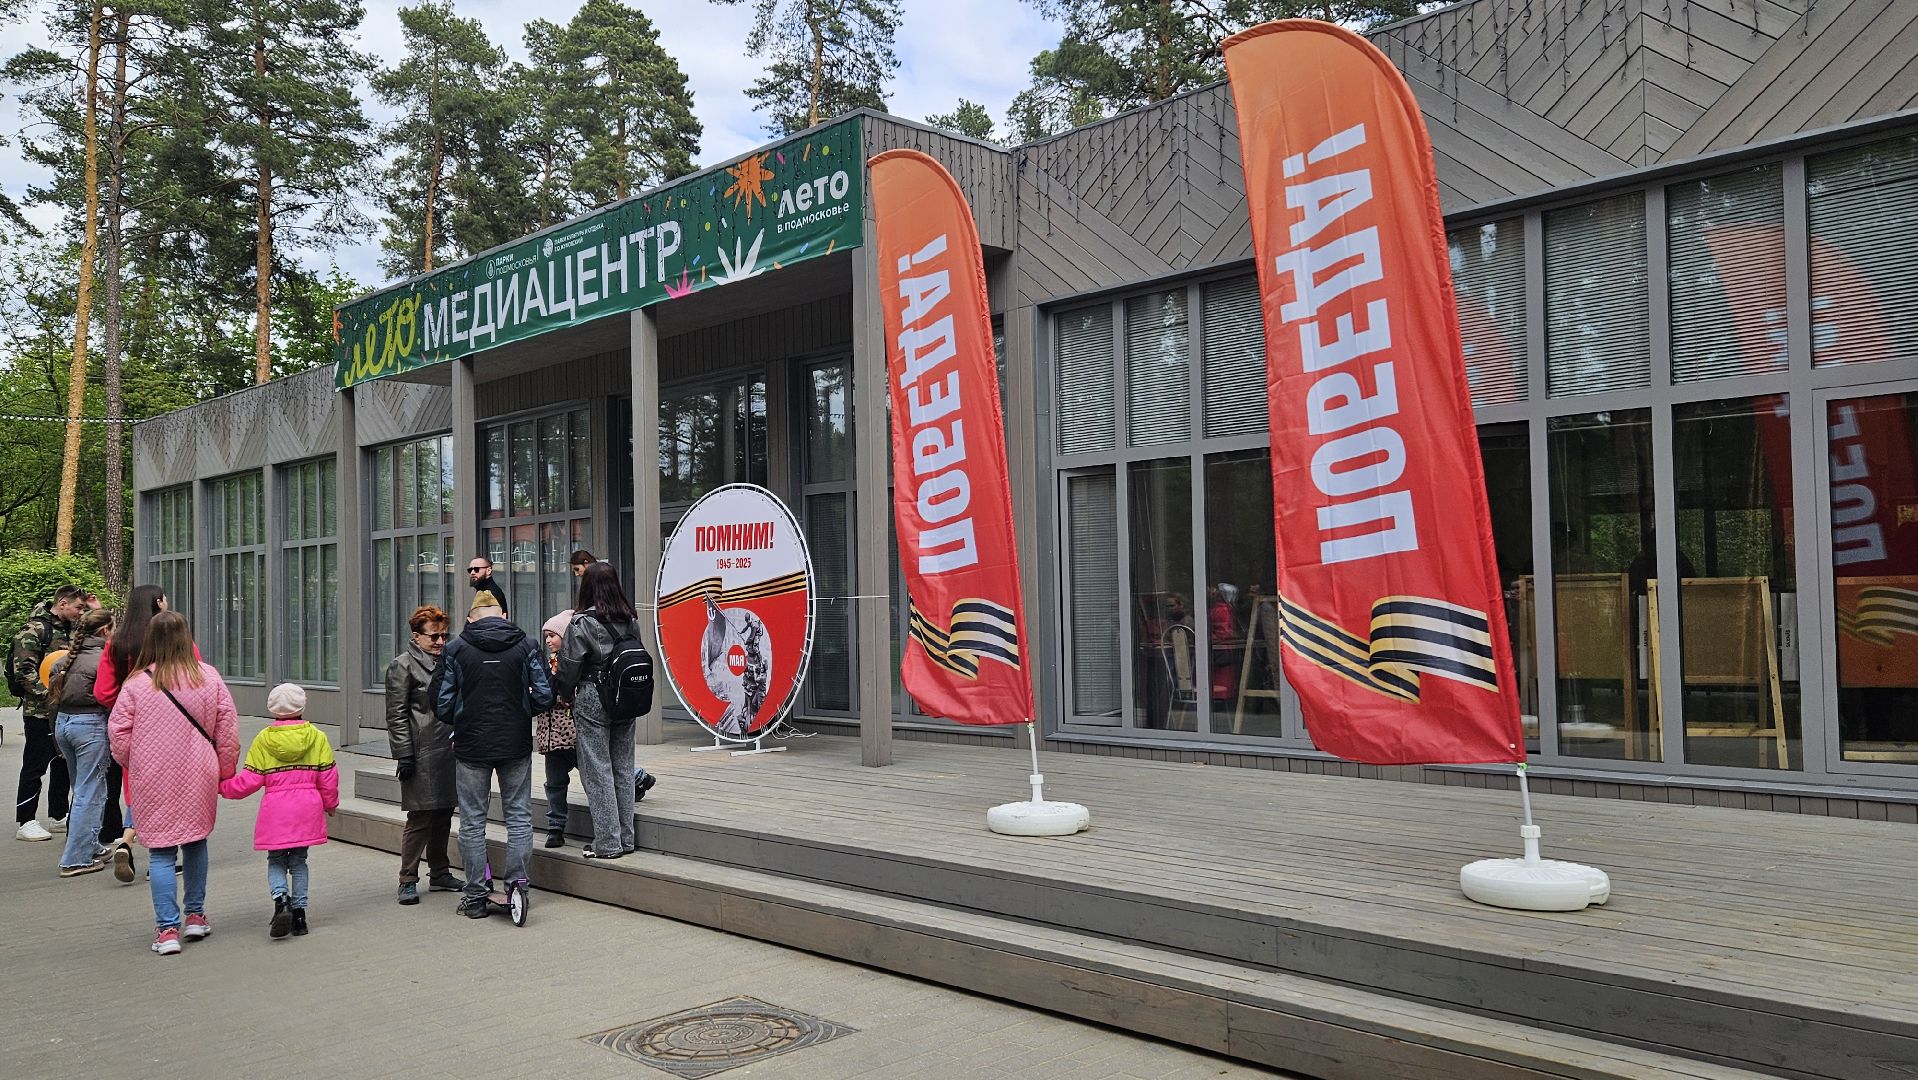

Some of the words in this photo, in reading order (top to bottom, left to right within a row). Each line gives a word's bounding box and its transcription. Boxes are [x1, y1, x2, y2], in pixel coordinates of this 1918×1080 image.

[495, 253, 514, 266] ПАРКИ
[495, 254, 537, 276] ПОДМОСКОВЬЯ
[423, 220, 682, 351] МЕДИАЦЕНТР
[695, 522, 774, 552] ПОМНИМ!
[716, 557, 752, 570] 1945-2025
[729, 654, 745, 666] МАЯ
